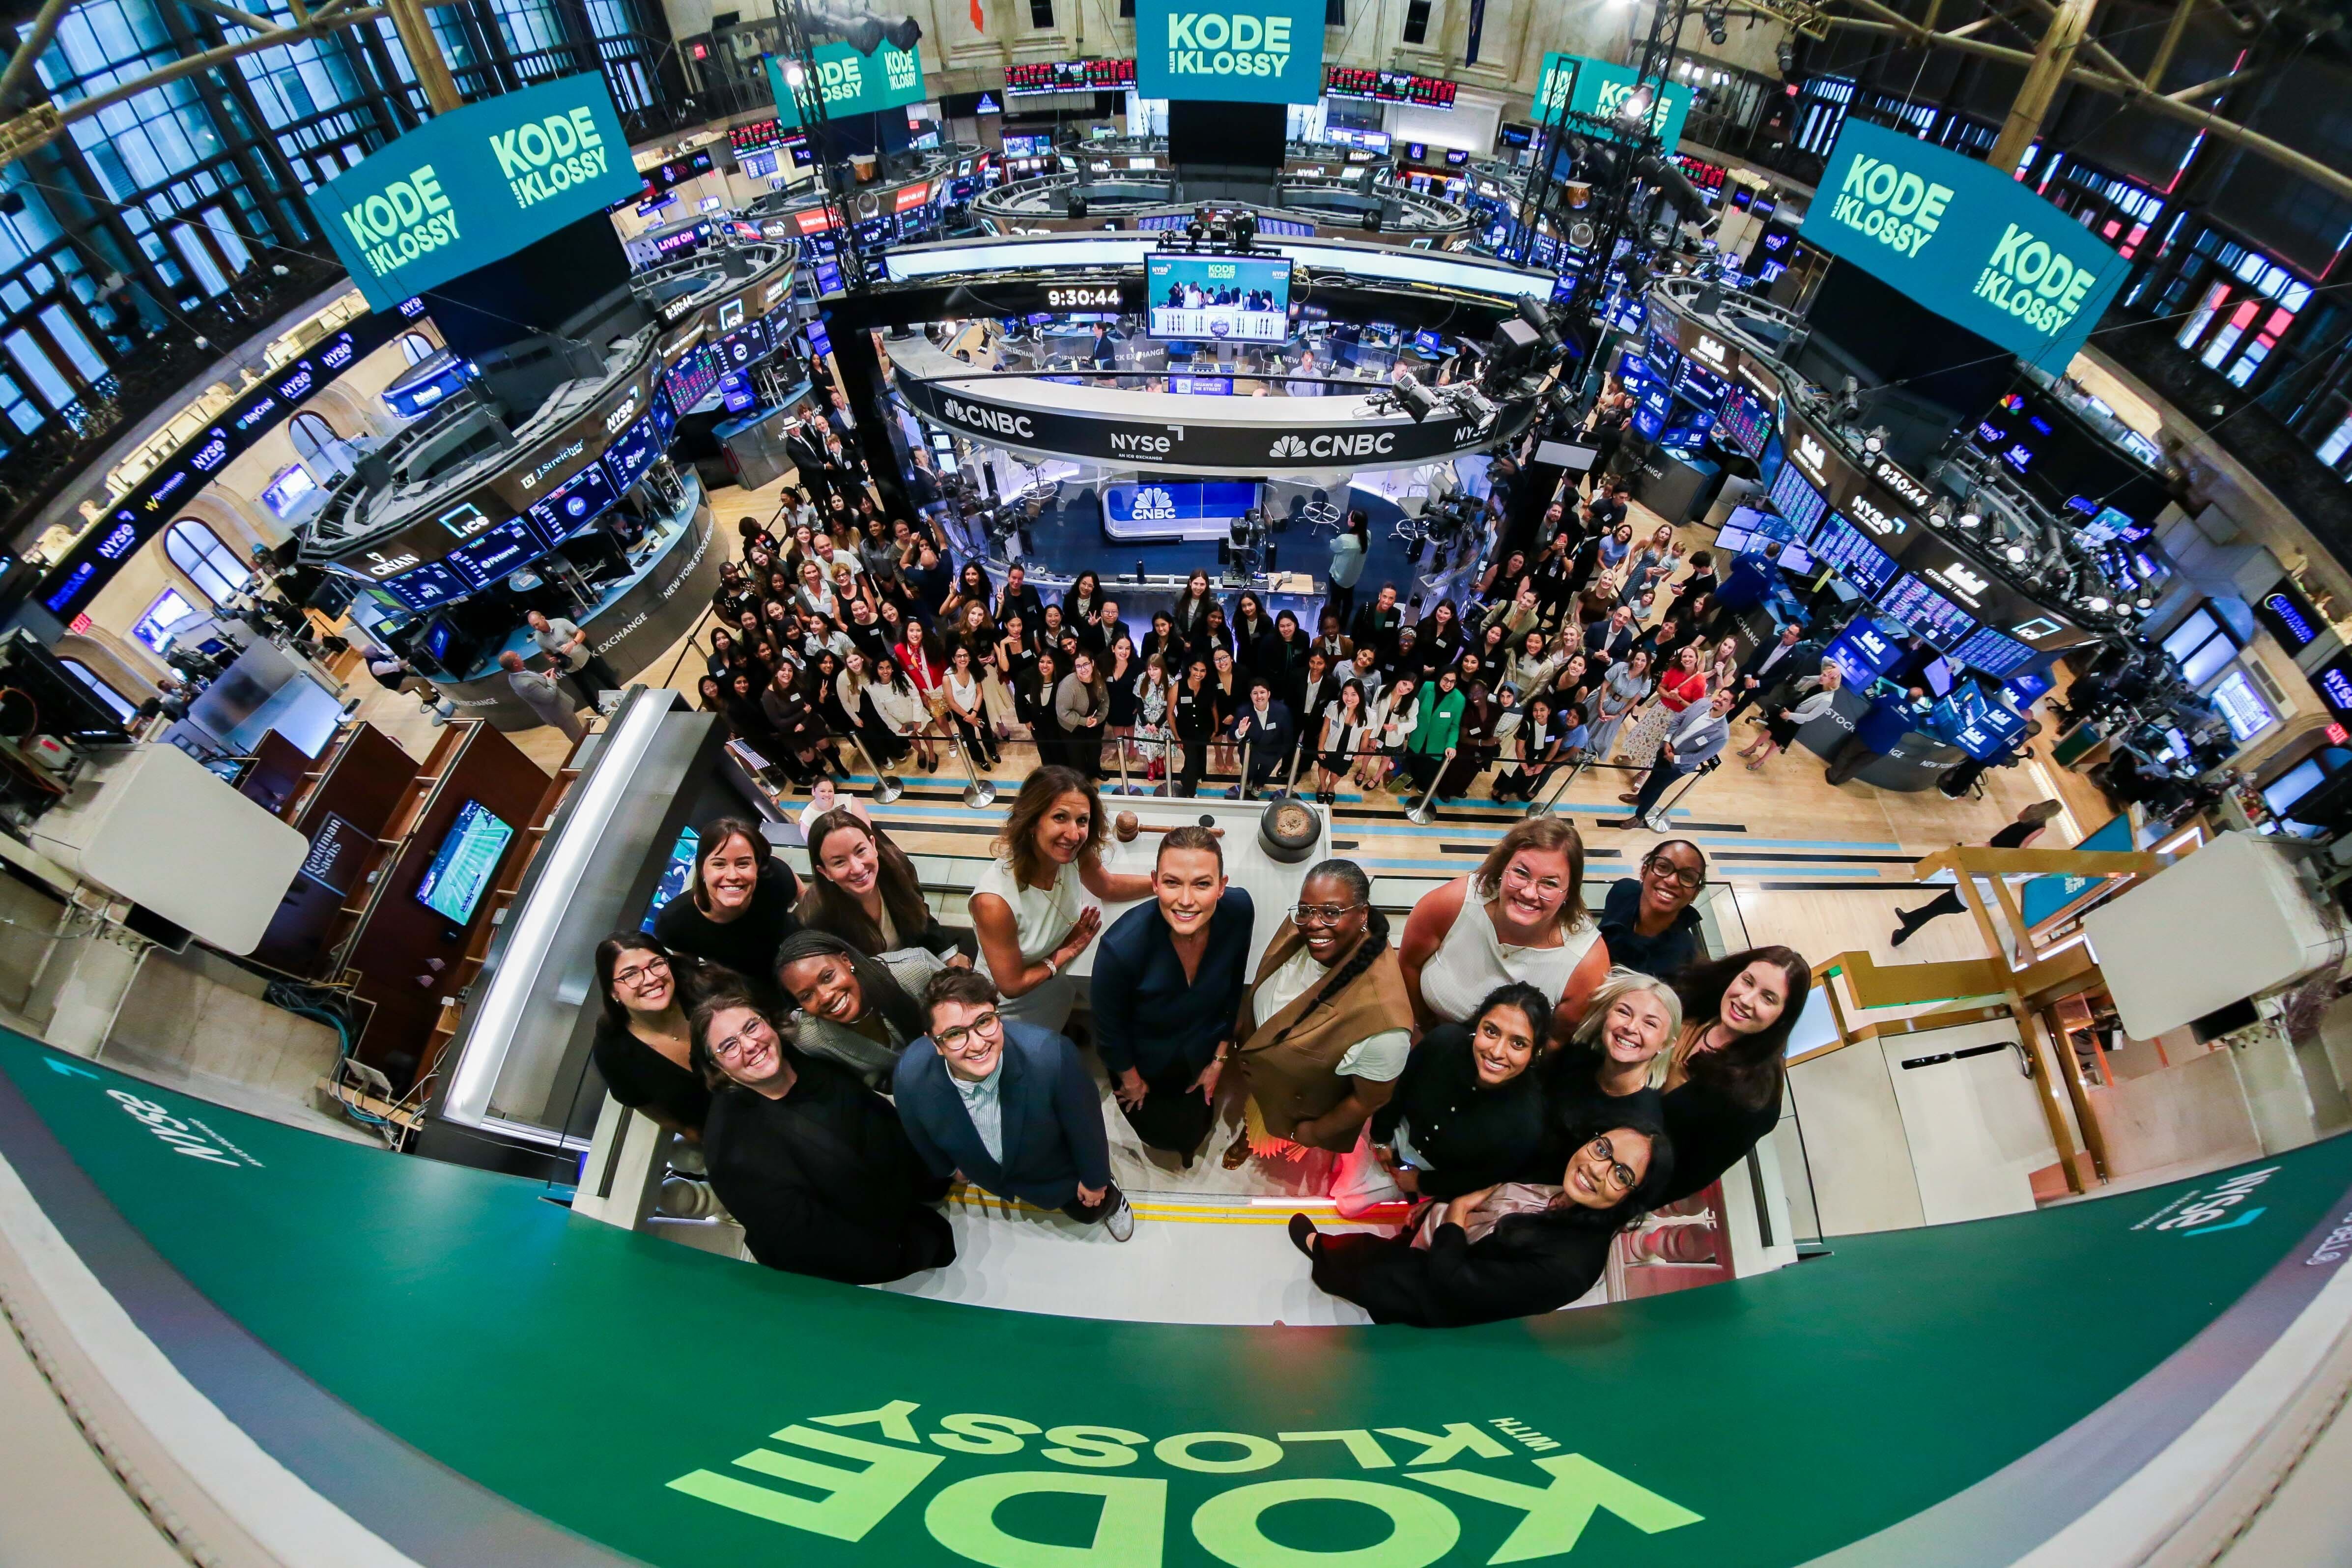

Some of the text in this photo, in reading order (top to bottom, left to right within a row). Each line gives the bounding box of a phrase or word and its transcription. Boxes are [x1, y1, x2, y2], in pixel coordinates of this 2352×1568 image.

[1168, 13, 1292, 53] KODE
[884, 50, 915, 75] KODE
[1178, 51, 1290, 77] KLOSSY
[489, 106, 602, 180] KODE
[517, 146, 608, 205] KLOSSY
[1842, 153, 1955, 233] KODE
[341, 164, 451, 251] KODE
[370, 209, 460, 274] KLOSSY
[658, 230, 695, 252] LIVE ON
[1836, 196, 1932, 258] KLOSSY
[1208, 264, 1236, 273] KODE
[1989, 223, 2097, 315] KODE
[665, 295, 693, 319] 9:30:44
[1048, 289, 1119, 306] 9:30:44
[1980, 270, 2072, 337] KLOSSY
[1282, 355, 1300, 365] NEW
[966, 405, 1034, 438] CNBC
[1310, 432, 1395, 457] CNBC
[1877, 463, 1929, 507] 9:30:44
[1132, 508, 1176, 520] CNBC
[370, 553, 420, 576] CRYAN
[662, 579, 680, 599] NEW
[680, 558, 697, 581] YORK
[694, 537, 708, 563] STOCK
[1925, 568, 1953, 588] CITADEL
[597, 611, 649, 655] EXCHANGE
[1825, 708, 1856, 733] STOCK
[305, 819, 341, 873] Goldman
[313, 841, 341, 878] Sachs
[807, 1399, 1513, 1473] KLOSSY
[1488, 1416, 1561, 1449] WITH
[664, 1423, 1707, 1568] KODE
